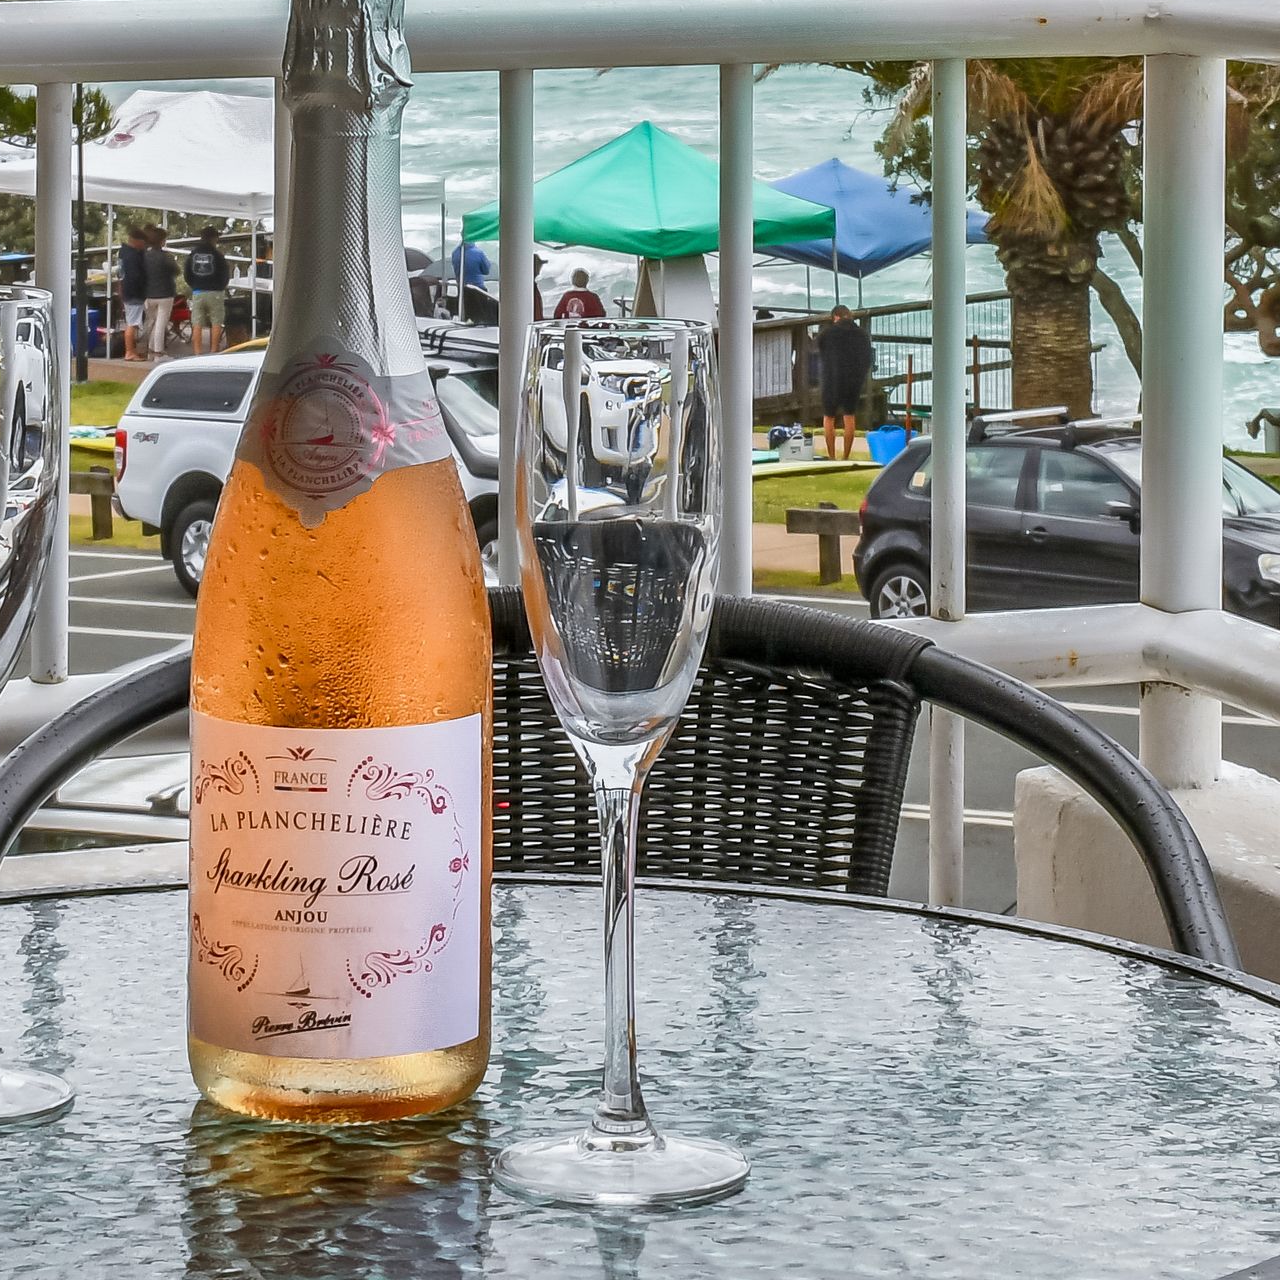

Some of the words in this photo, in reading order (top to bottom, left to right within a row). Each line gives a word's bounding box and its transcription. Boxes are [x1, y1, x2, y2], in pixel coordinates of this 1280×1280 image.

[273, 770, 328, 786] FRANCE
[210, 812, 229, 833] LA
[236, 810, 413, 841] PLANCHELIÈRE
[206, 846, 329, 909] Sparkling
[337, 854, 416, 894] Rosé
[274, 909, 328, 925] ANJOU
